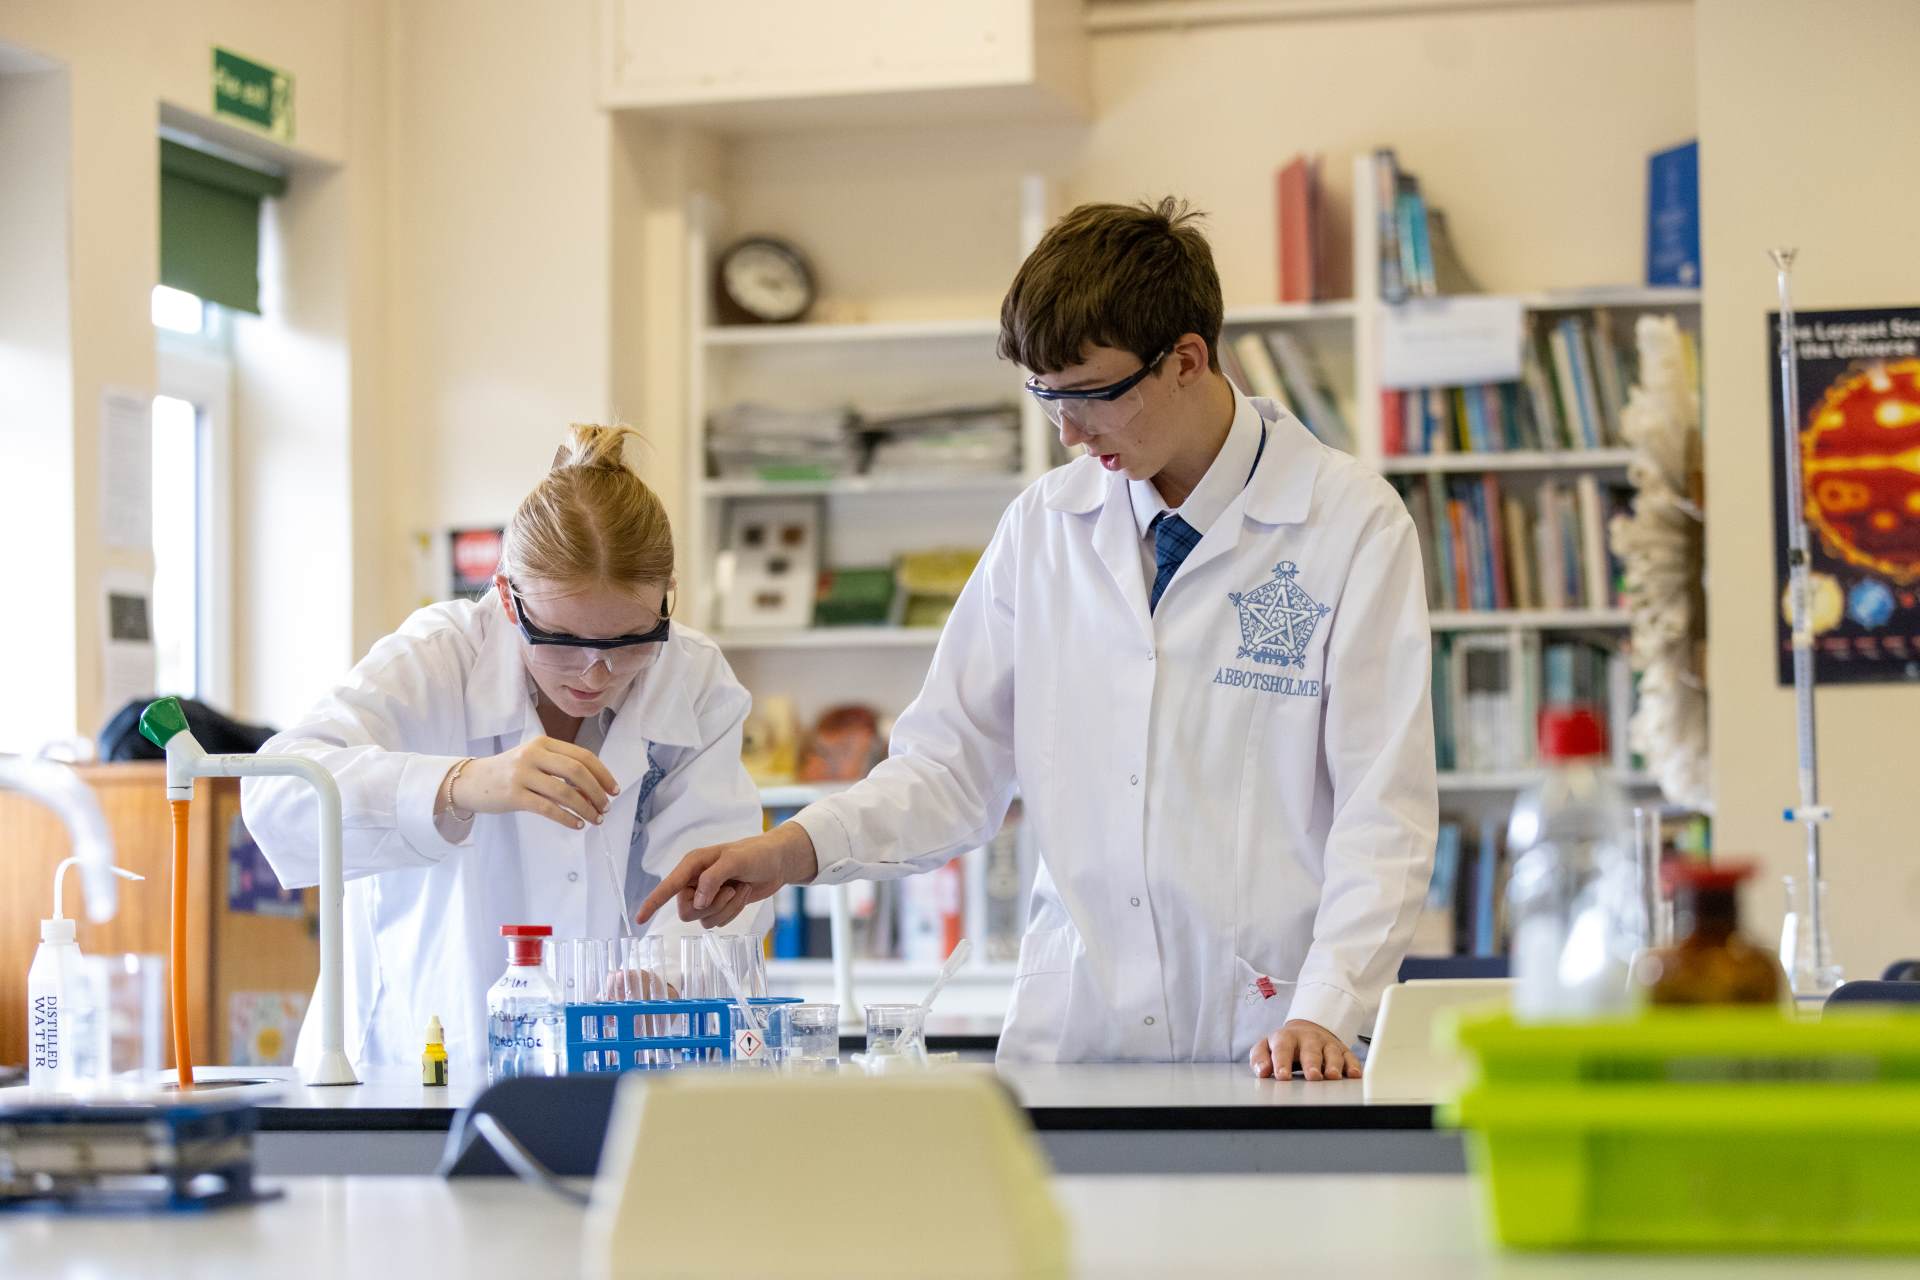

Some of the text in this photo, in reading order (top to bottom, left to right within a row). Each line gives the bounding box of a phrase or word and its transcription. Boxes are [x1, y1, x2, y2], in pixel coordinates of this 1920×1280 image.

[1813, 320, 1888, 345] Largest
[1800, 341, 1832, 359] the
[1834, 338, 1916, 359] Universe
[1213, 666, 1320, 697] ABBOTSHOLME
[34, 996, 46, 1068] WATER
[47, 995, 58, 1069] DISTILLED
